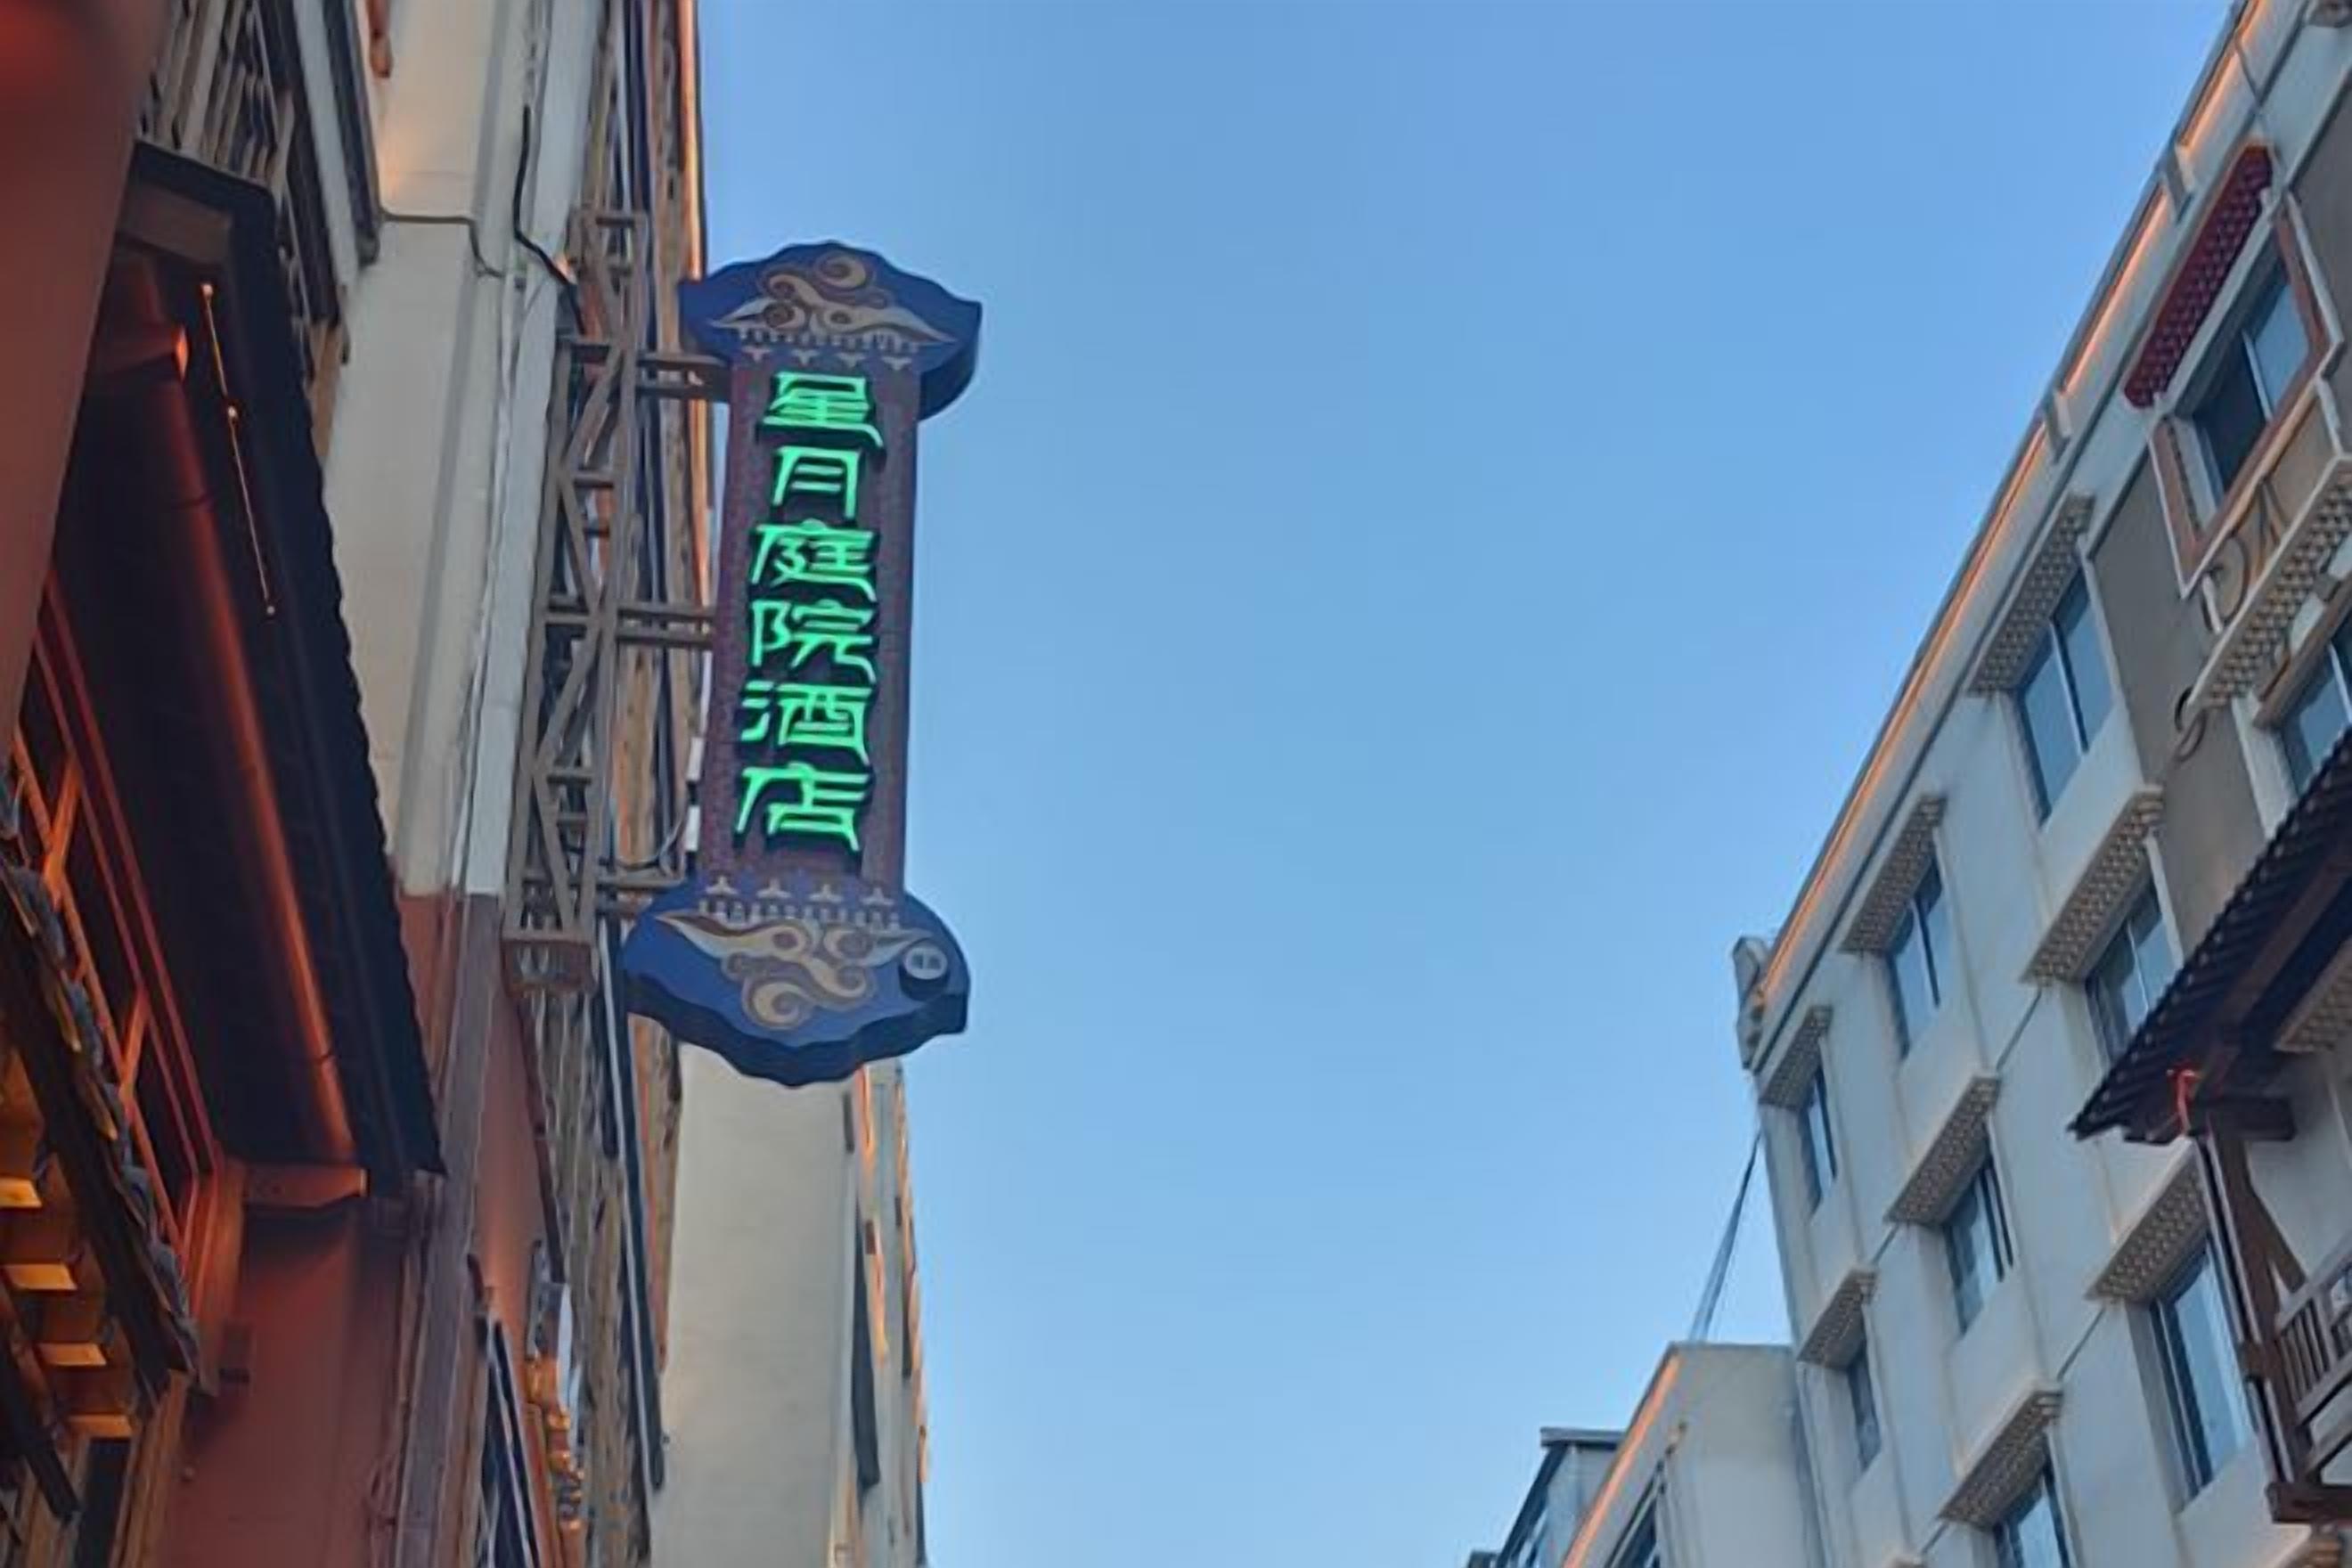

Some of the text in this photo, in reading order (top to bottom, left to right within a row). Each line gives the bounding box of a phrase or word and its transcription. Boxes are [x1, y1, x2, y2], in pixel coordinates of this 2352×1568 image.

[734, 371, 883, 852] 星月庭院酒店
